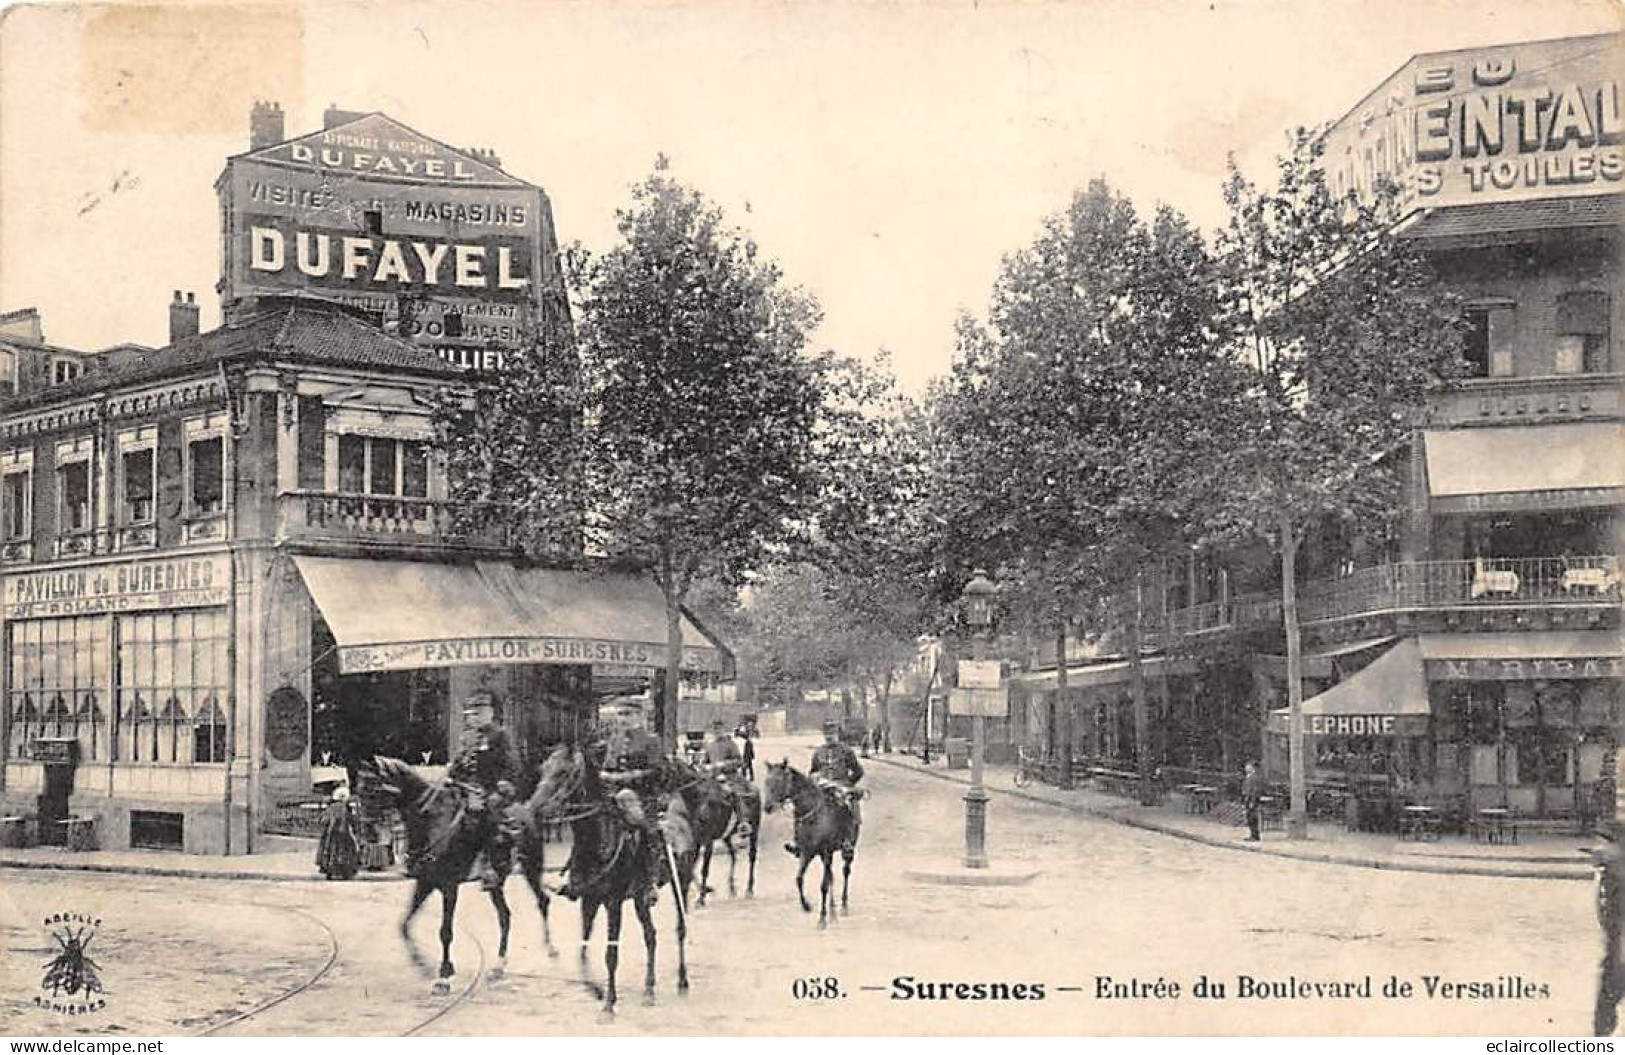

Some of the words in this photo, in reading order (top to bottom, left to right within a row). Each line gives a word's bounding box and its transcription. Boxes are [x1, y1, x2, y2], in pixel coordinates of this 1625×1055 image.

[292, 144, 474, 177] DUFAYEL
[1463, 149, 1624, 193] TOILES
[406, 200, 527, 227] MAGASINS
[250, 224, 529, 288] DUFAYEL
[16, 570, 86, 602] PAVILLON
[424, 641, 530, 661] PAVILLON
[544, 641, 648, 662] SURESNES
[1303, 715, 1395, 735] EPHONE
